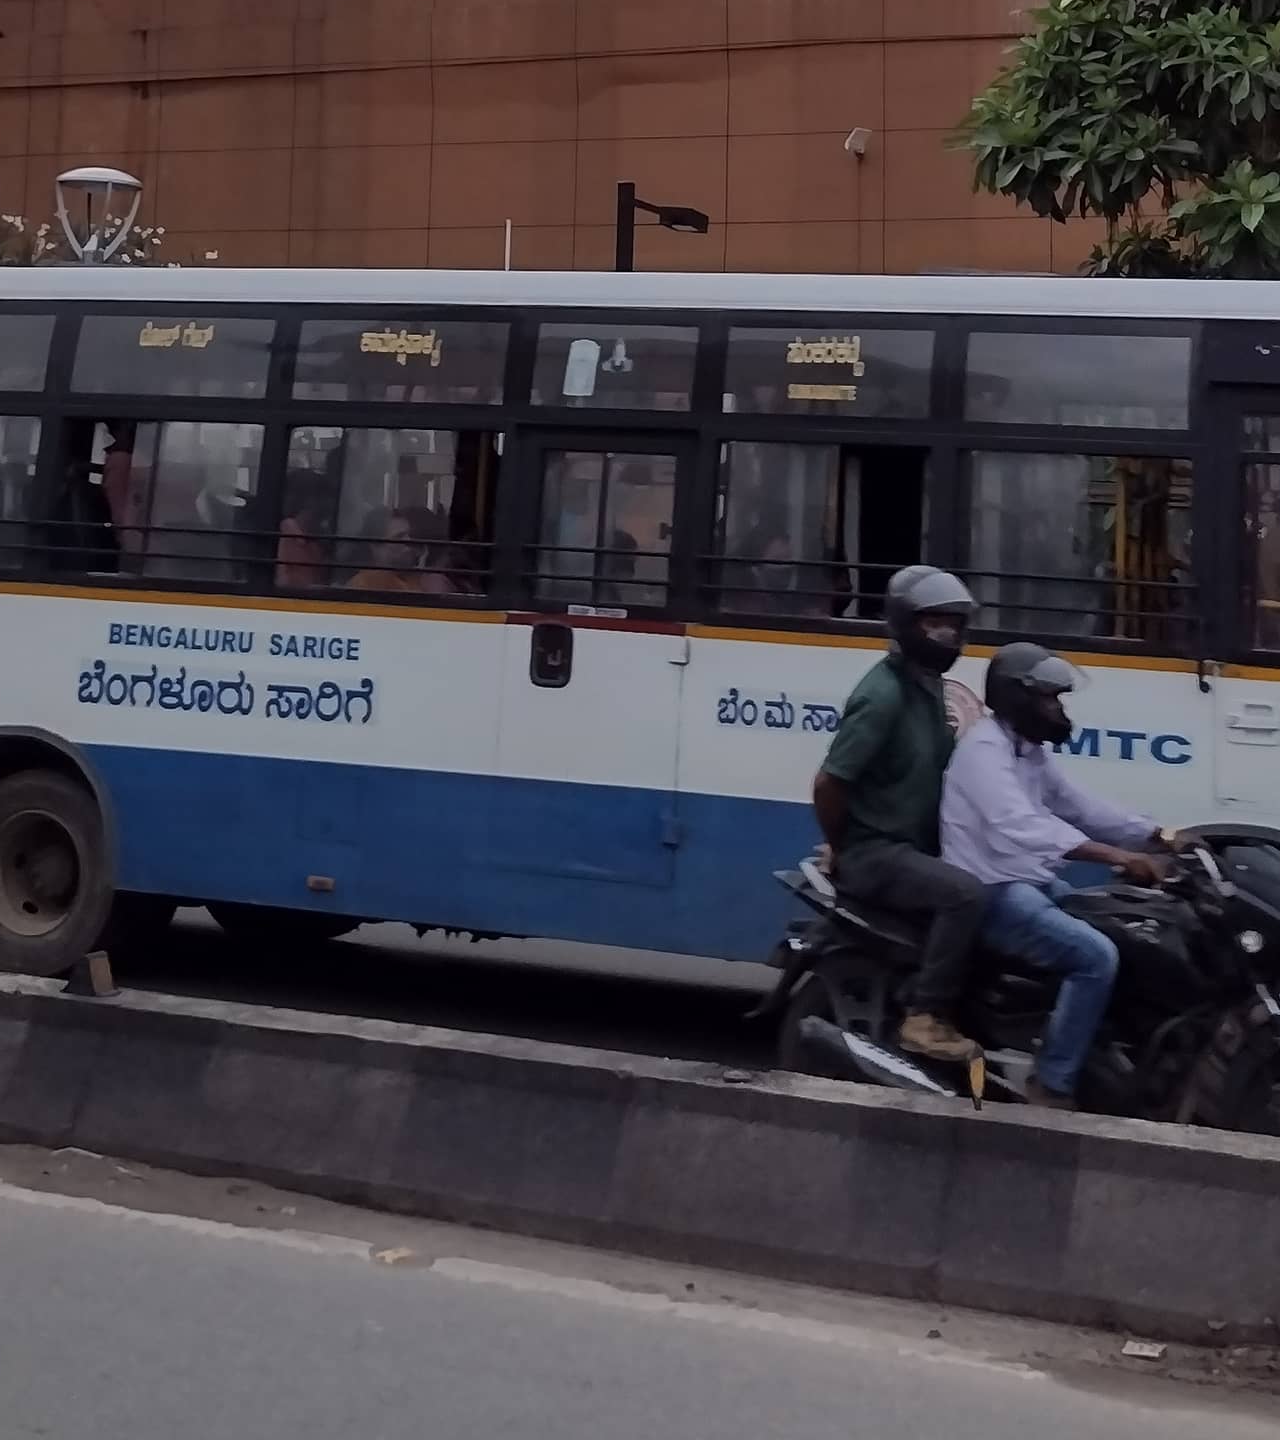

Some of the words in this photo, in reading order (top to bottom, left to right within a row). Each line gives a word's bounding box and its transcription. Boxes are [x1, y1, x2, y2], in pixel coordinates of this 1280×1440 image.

[108, 622, 255, 654] BENGALURU
[270, 633, 361, 661] SARIGE
[77, 659, 255, 716] ಬೆಂಗಳೂರು
[265, 677, 375, 725] ಸಾರಿಗೆ
